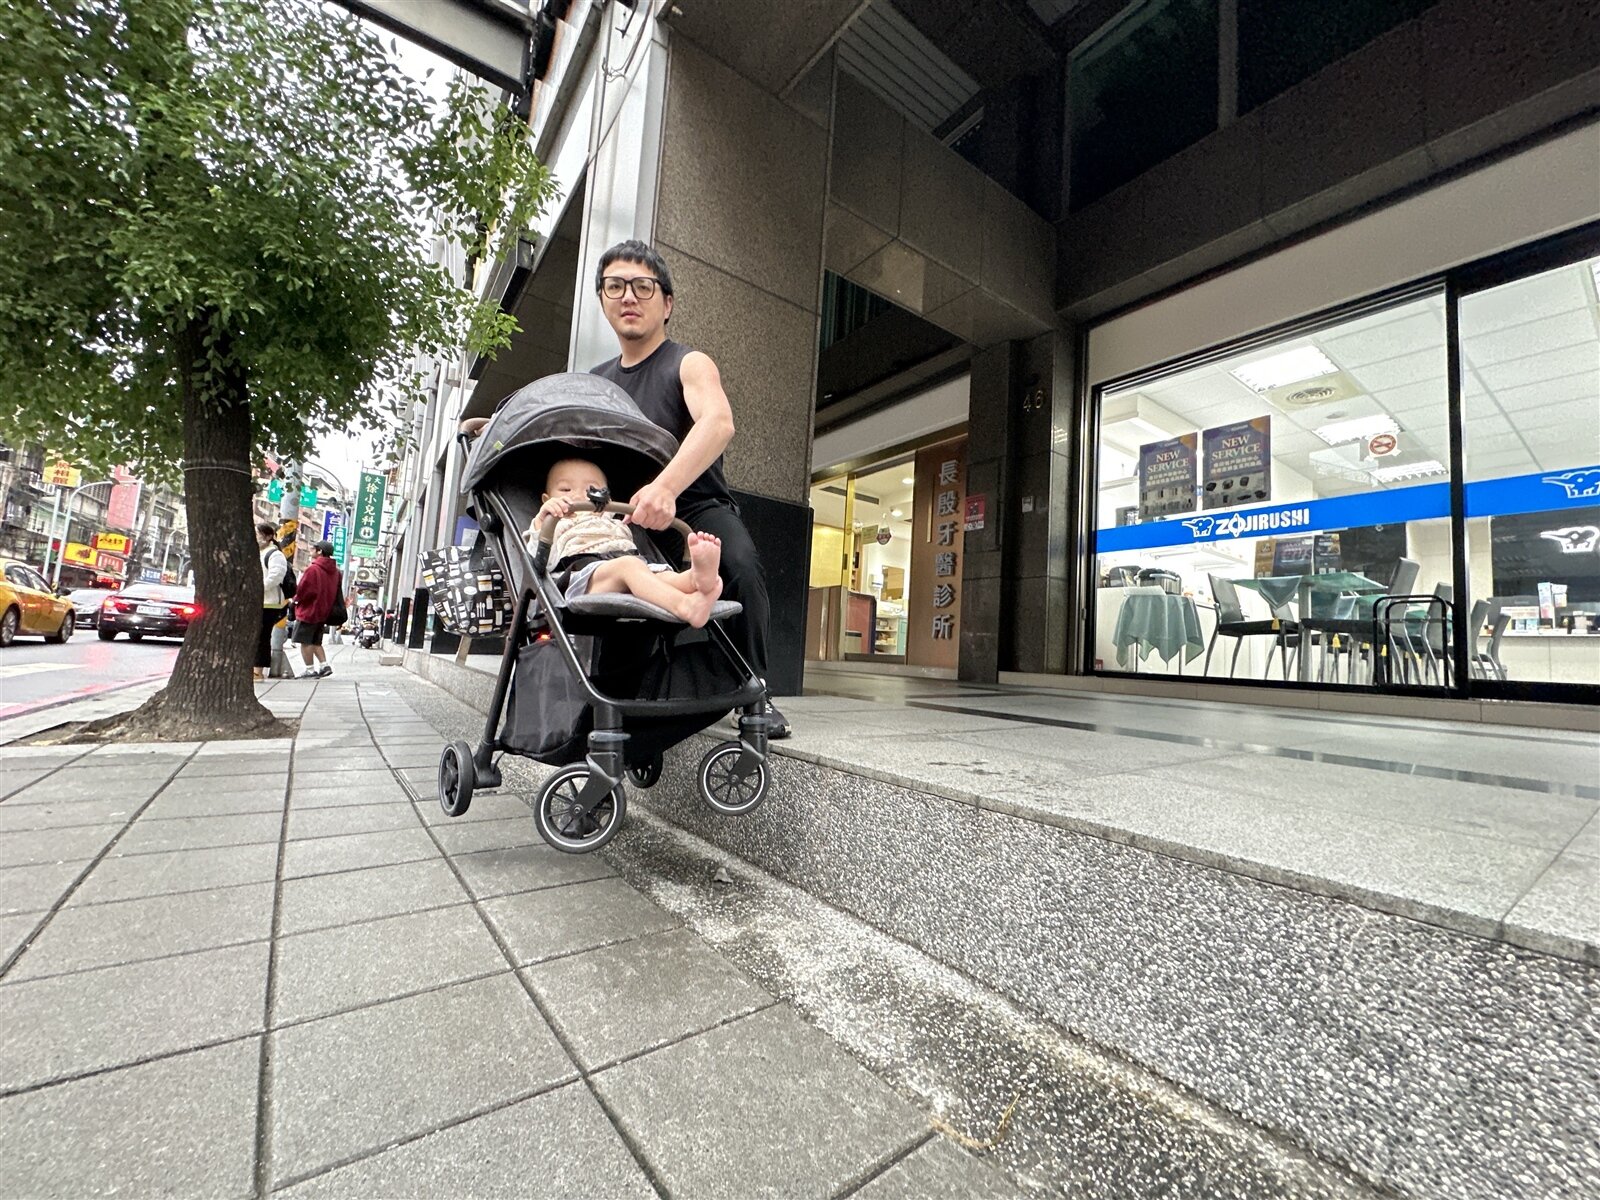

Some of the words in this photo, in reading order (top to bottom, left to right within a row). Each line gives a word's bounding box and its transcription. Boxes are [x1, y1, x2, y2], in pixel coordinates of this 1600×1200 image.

[1222, 434, 1251, 449] NEW
[1156, 450, 1181, 463] NEW
[1211, 443, 1261, 460] SERVICE
[1147, 457, 1189, 473] SERVICE
[361, 483, 379, 526] 徐小兒科
[1215, 508, 1310, 537] ZOJIRUSHI
[932, 459, 959, 640] 長殷牙醫診所
